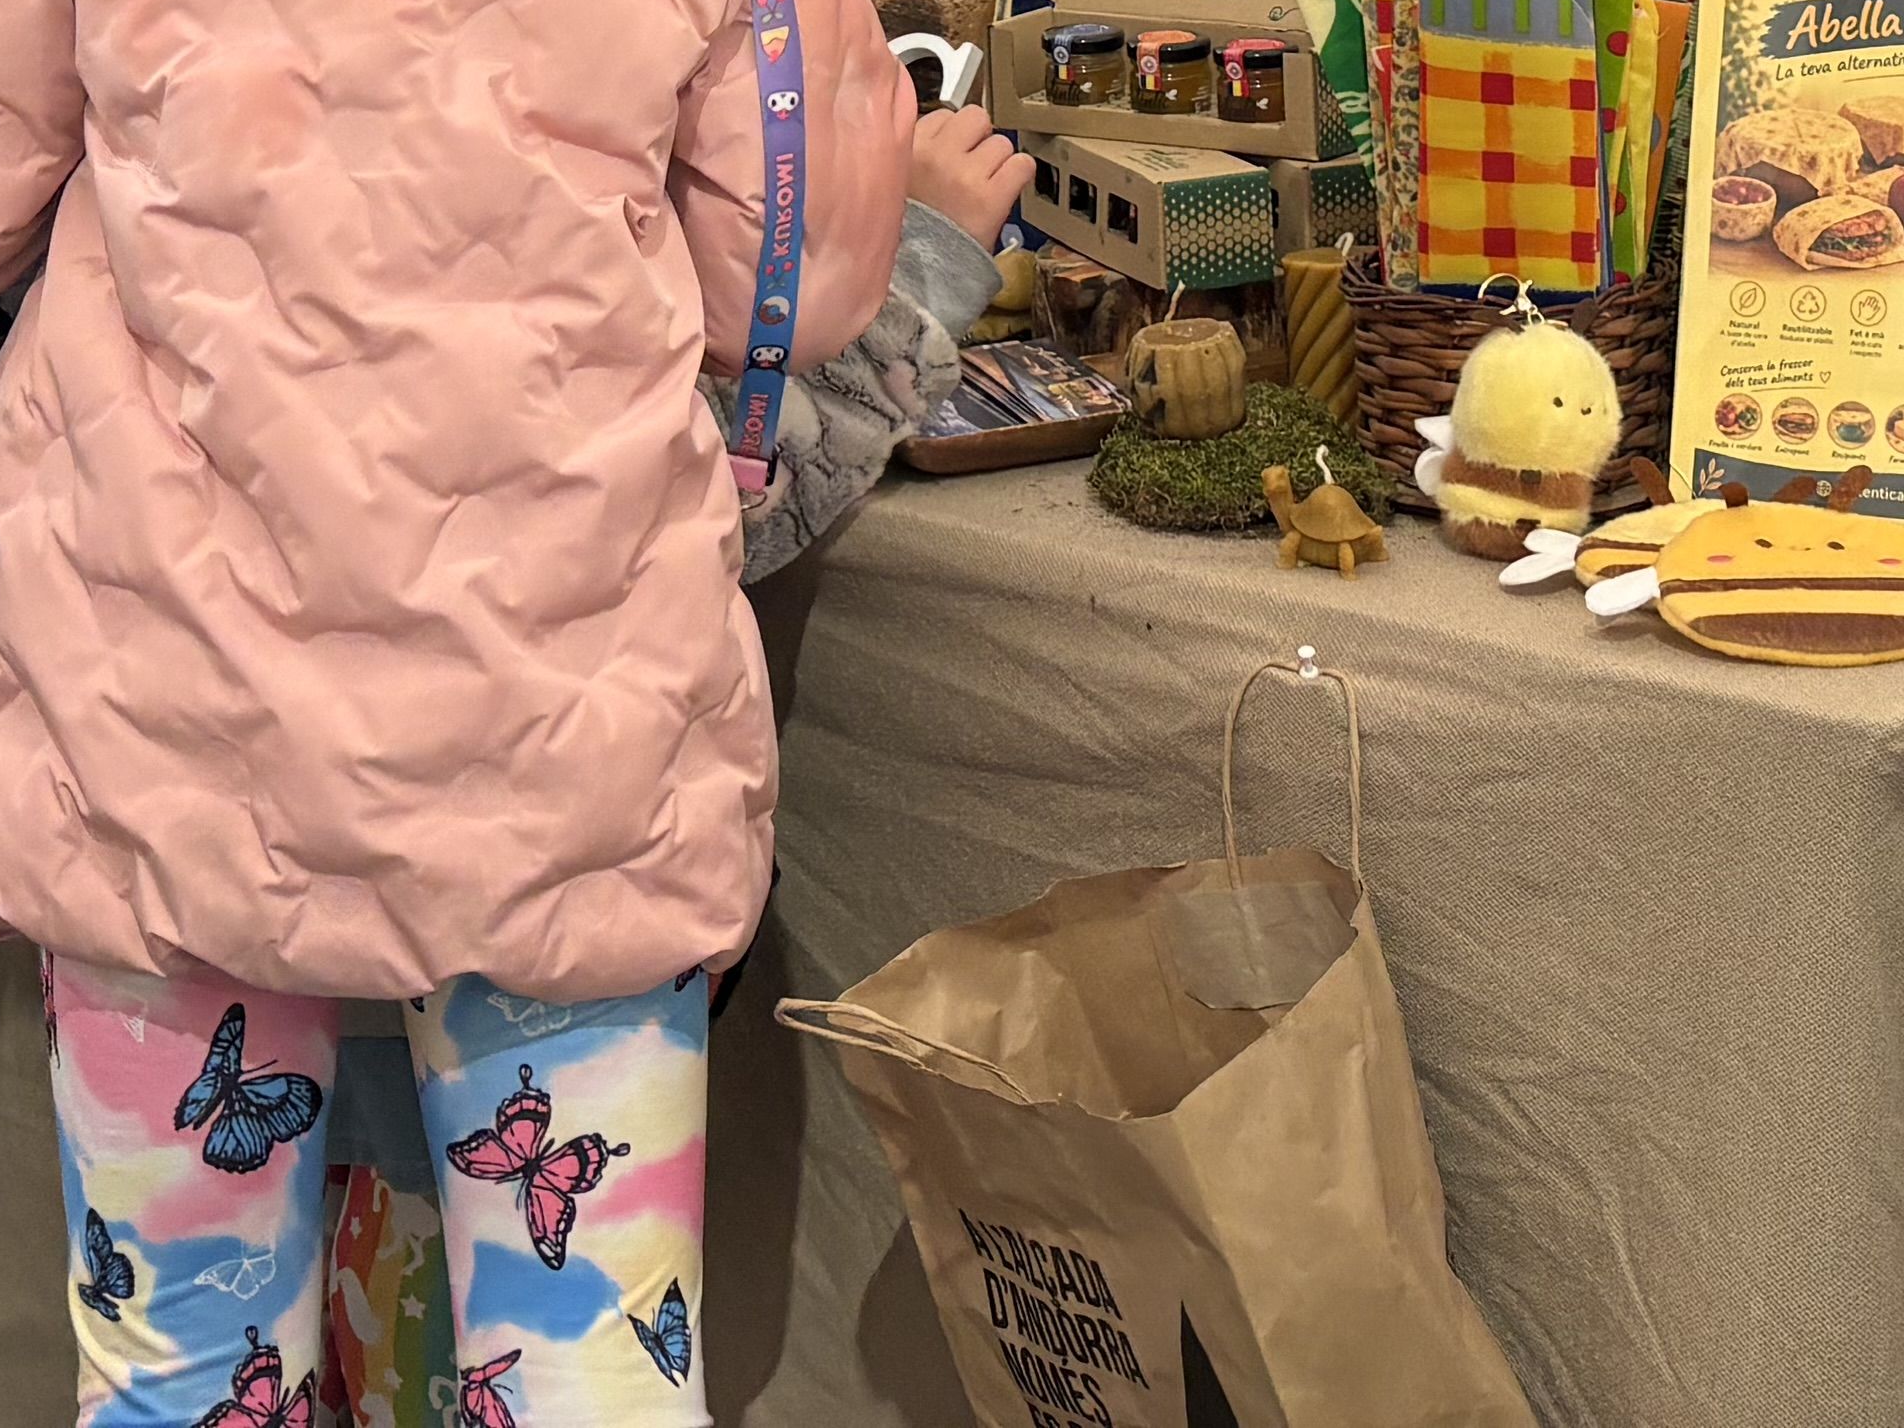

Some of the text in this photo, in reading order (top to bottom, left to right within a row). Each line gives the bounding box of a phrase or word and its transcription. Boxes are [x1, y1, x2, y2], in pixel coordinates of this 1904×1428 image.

[1786, 0, 1903, 50] Abella
[1776, 64, 1794, 81] La
[1800, 62, 1832, 77] teva
[1721, 364, 1763, 376] Conserva
[1767, 360, 1775, 370] la
[983, 1267, 1150, 1389] D'ANDORRA
